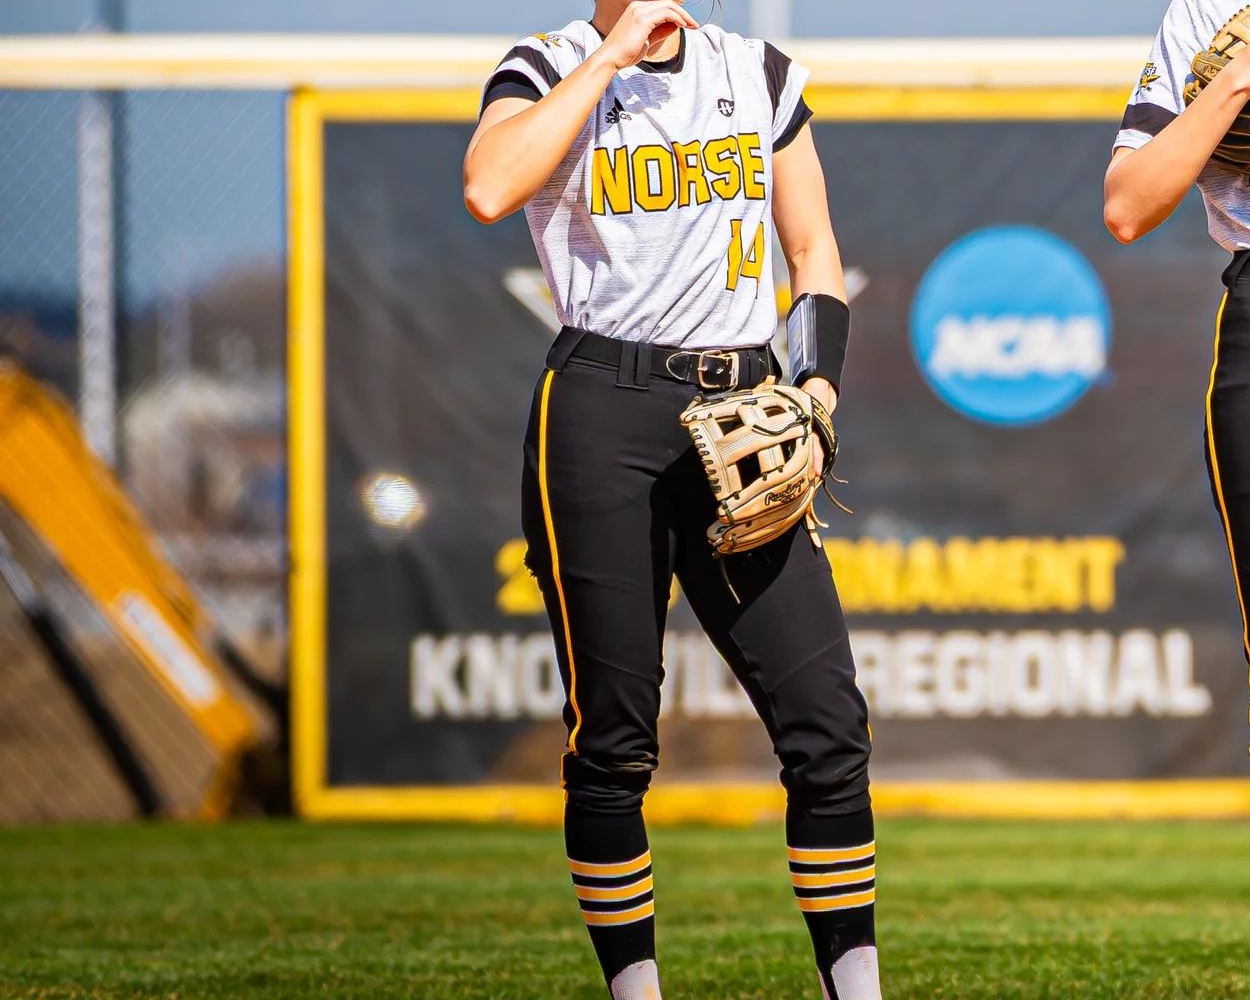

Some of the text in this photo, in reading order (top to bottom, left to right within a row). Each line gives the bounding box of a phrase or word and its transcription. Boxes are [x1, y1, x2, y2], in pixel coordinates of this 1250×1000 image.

[590, 132, 766, 216] NORSE
[726, 219, 765, 298] 14
[928, 315, 1106, 379] NCAA
[847, 629, 1213, 717] REGIONAL
